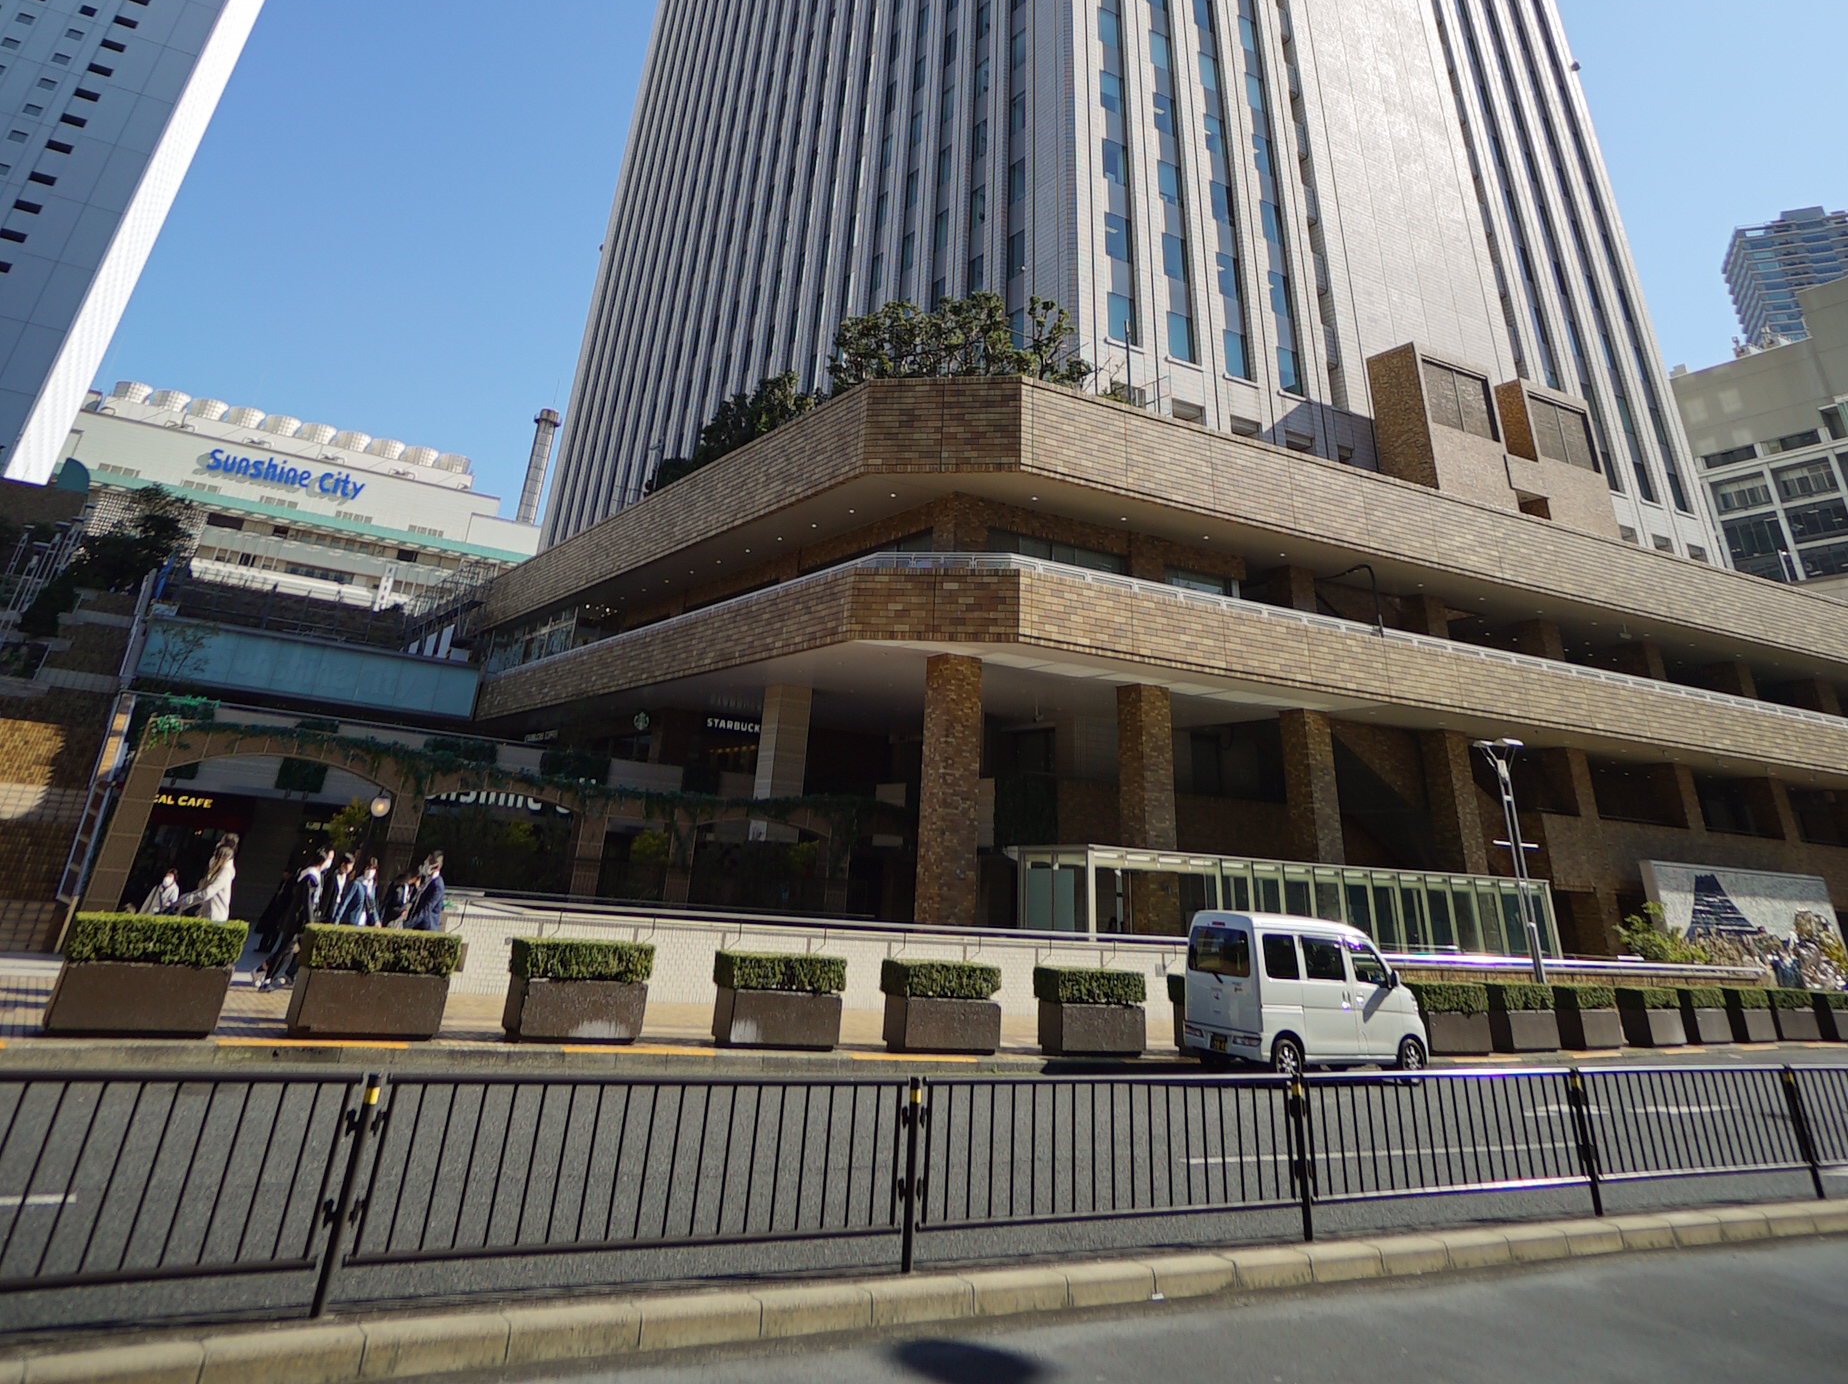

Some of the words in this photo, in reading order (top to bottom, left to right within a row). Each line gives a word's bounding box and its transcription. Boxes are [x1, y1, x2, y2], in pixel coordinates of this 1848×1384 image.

[206, 448, 312, 488] Sunshine
[318, 471, 366, 500] City
[706, 717, 761, 734] STARBUCK
[153, 794, 175, 805] CAL
[177, 795, 214, 809] CAFE
